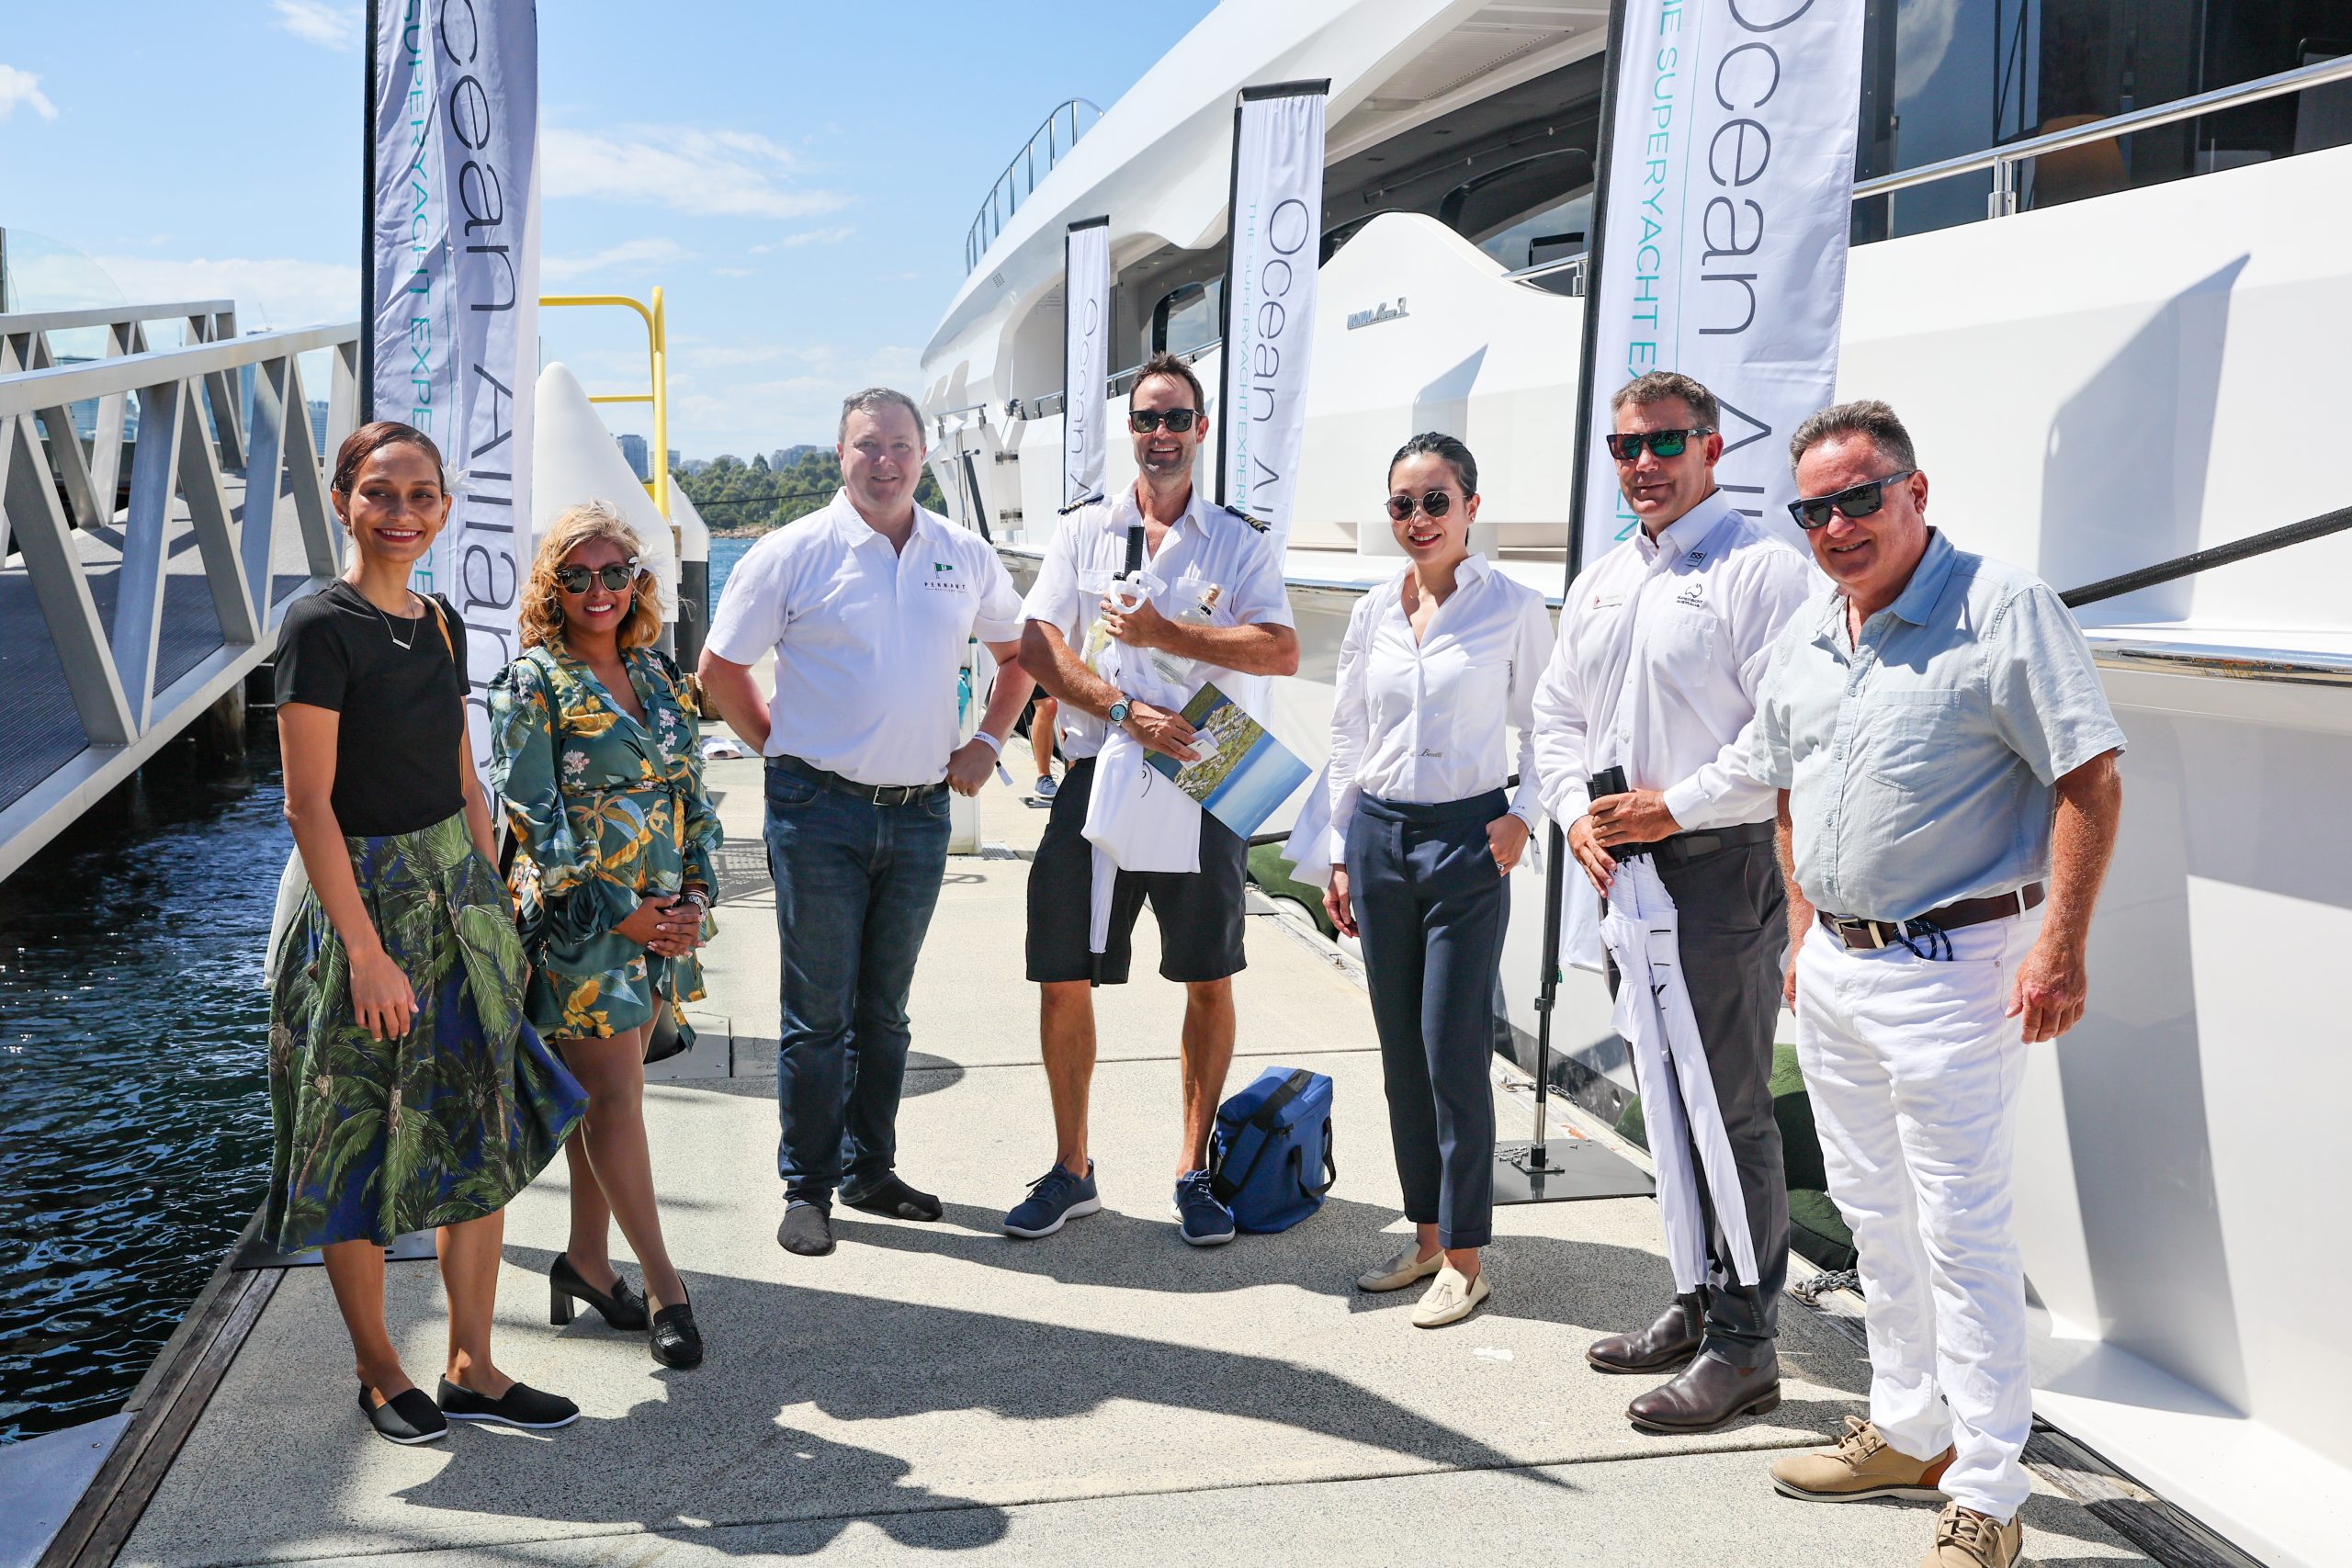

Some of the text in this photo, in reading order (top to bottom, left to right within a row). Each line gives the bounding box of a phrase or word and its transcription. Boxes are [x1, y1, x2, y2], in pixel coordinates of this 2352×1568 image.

[440, 0, 516, 311] cean
[1247, 198, 1258, 246] THE
[1631, 47, 1678, 331] SUPERYACHT
[1238, 255, 1252, 414] SUPERYACHT
[1252, 198, 1309, 422] Ocean
[924, 581, 966, 590] PENNANT
